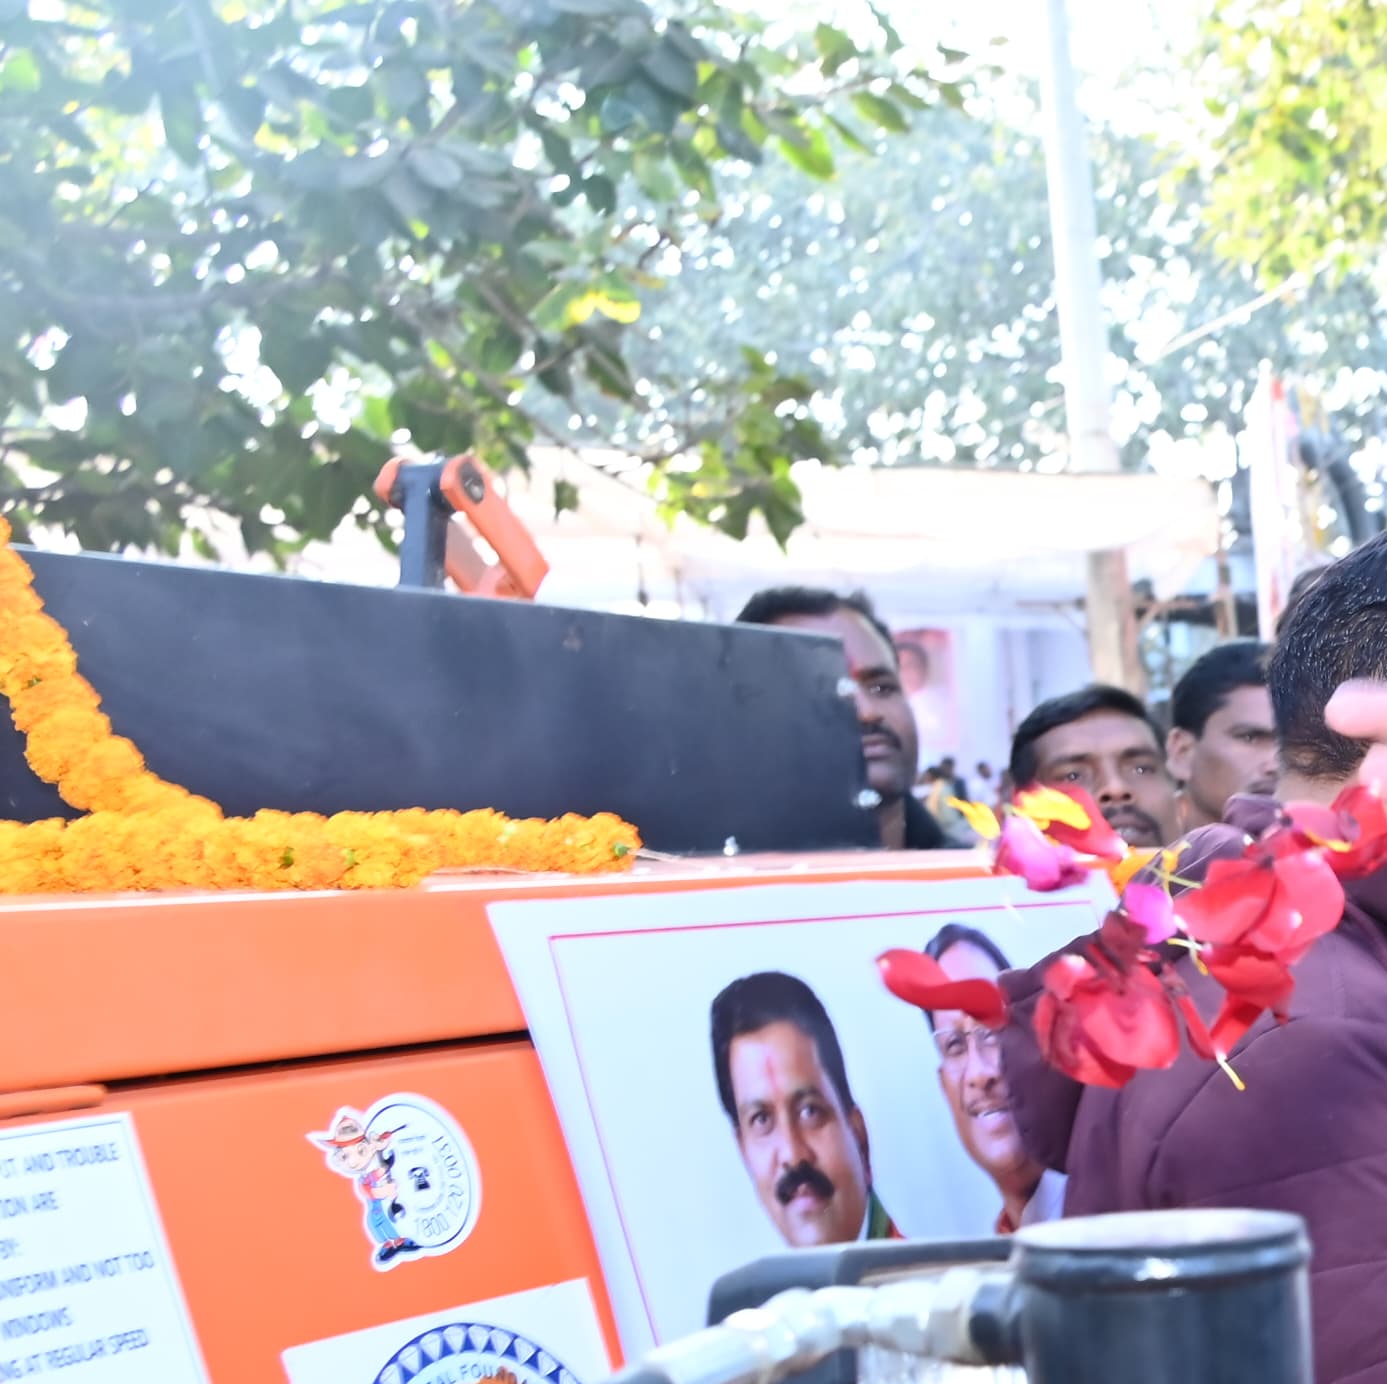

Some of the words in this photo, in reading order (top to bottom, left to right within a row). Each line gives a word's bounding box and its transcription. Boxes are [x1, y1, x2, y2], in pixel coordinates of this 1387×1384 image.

[24, 1152, 55, 1173] AND
[56, 1142, 119, 1169] TROUBLE
[32, 1190, 59, 1212] ARE
[62, 1264, 92, 1288] AND
[94, 1257, 121, 1278] NOT
[124, 1250, 155, 1271] TOO
[1, 1306, 74, 1340] WINDOWS
[25, 1353, 42, 1374] AT
[45, 1339, 107, 1370] REGULAR
[107, 1328, 150, 1355] SPEED
